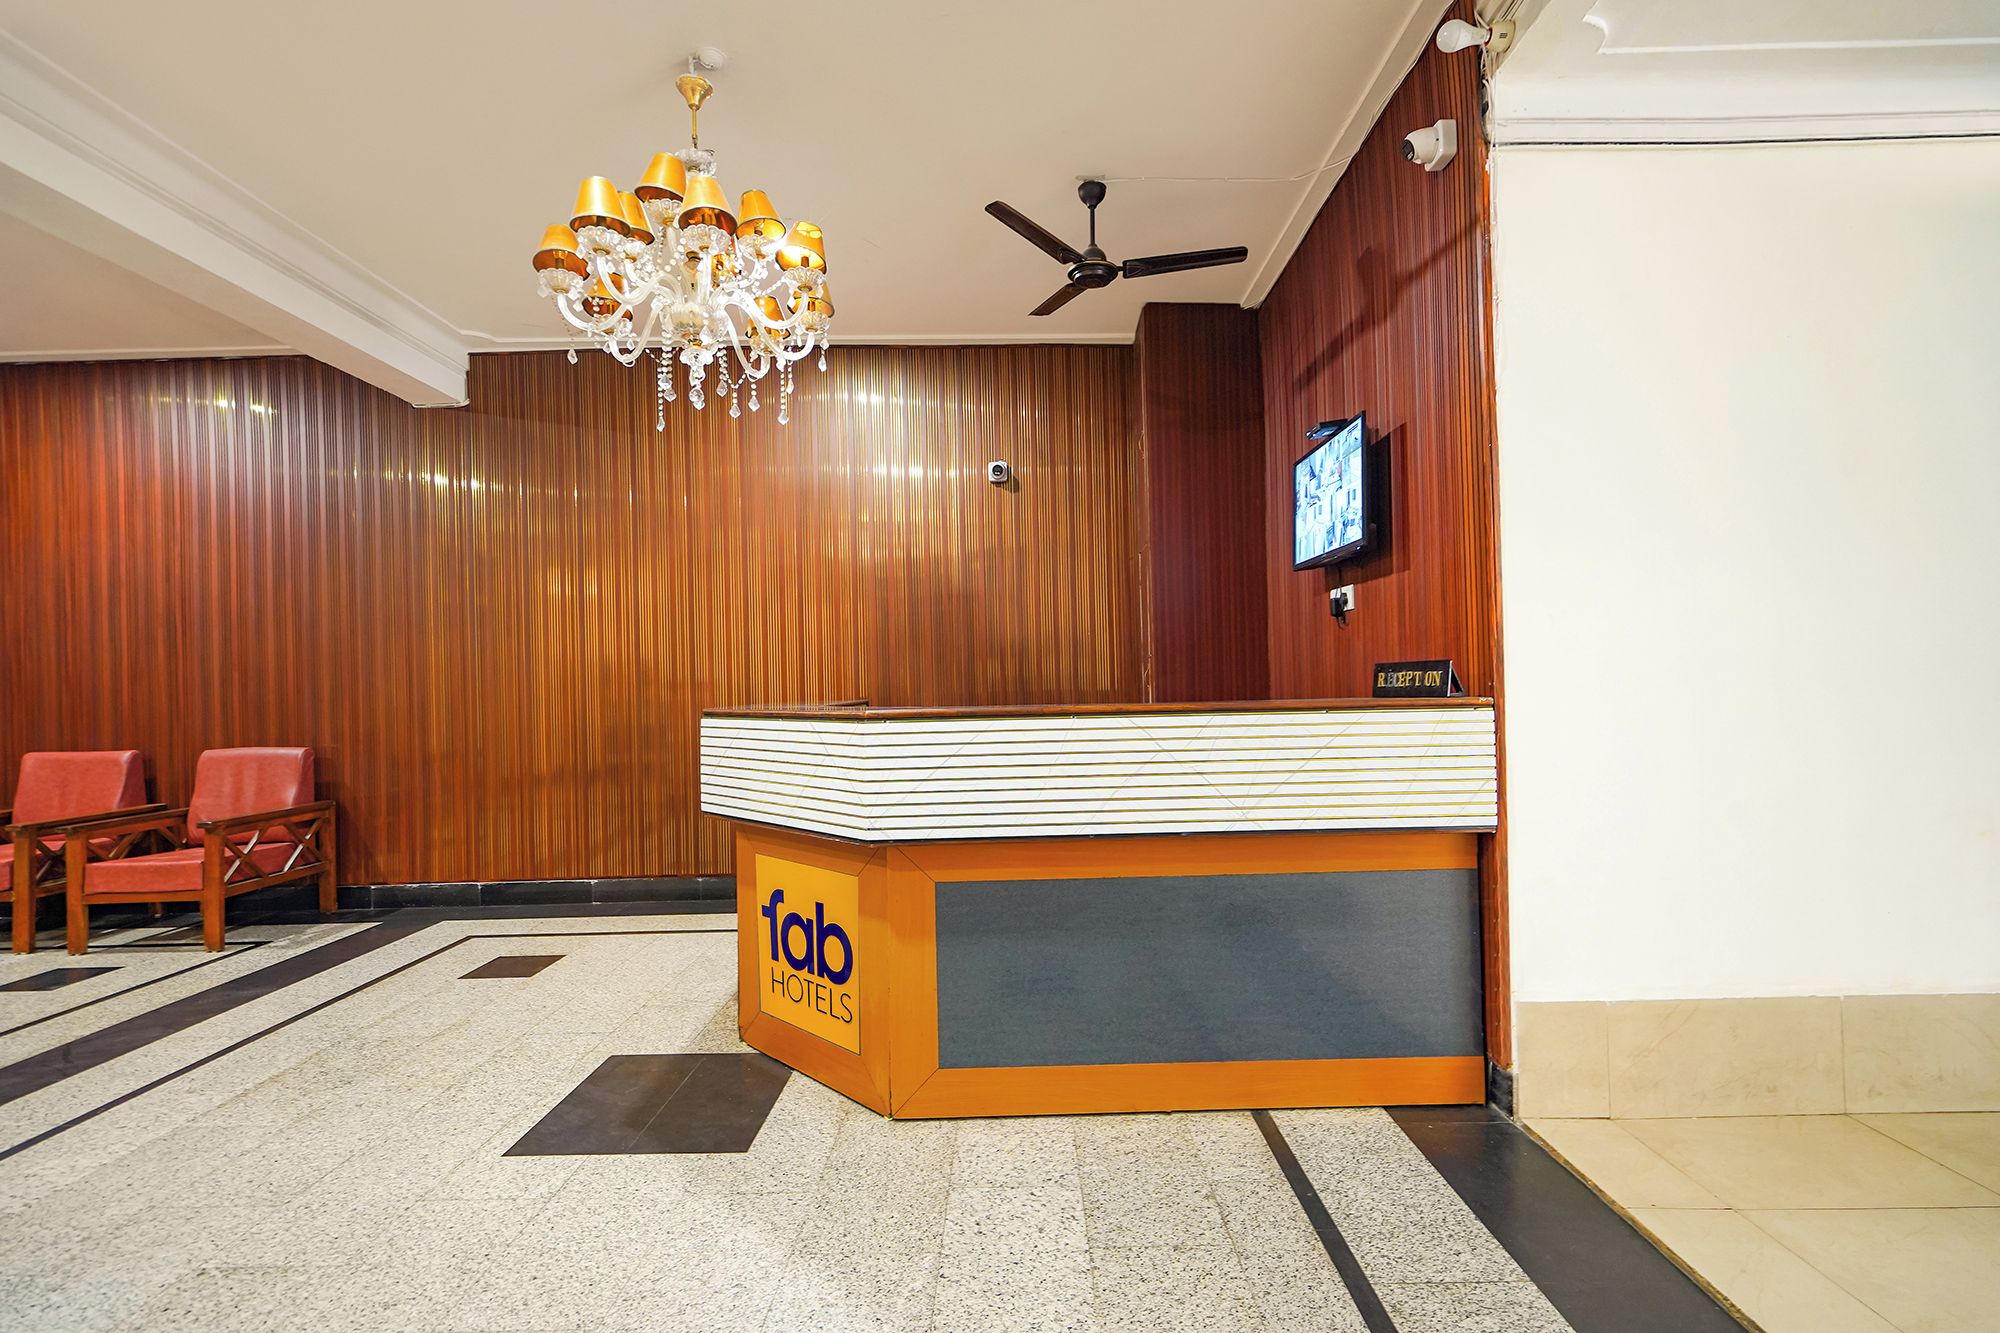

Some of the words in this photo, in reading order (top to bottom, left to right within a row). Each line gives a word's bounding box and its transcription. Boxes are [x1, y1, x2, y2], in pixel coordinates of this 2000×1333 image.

[1377, 670, 1443, 687] RECEPTON
[761, 888, 853, 985] fab
[771, 966, 853, 1024] HOTELS
